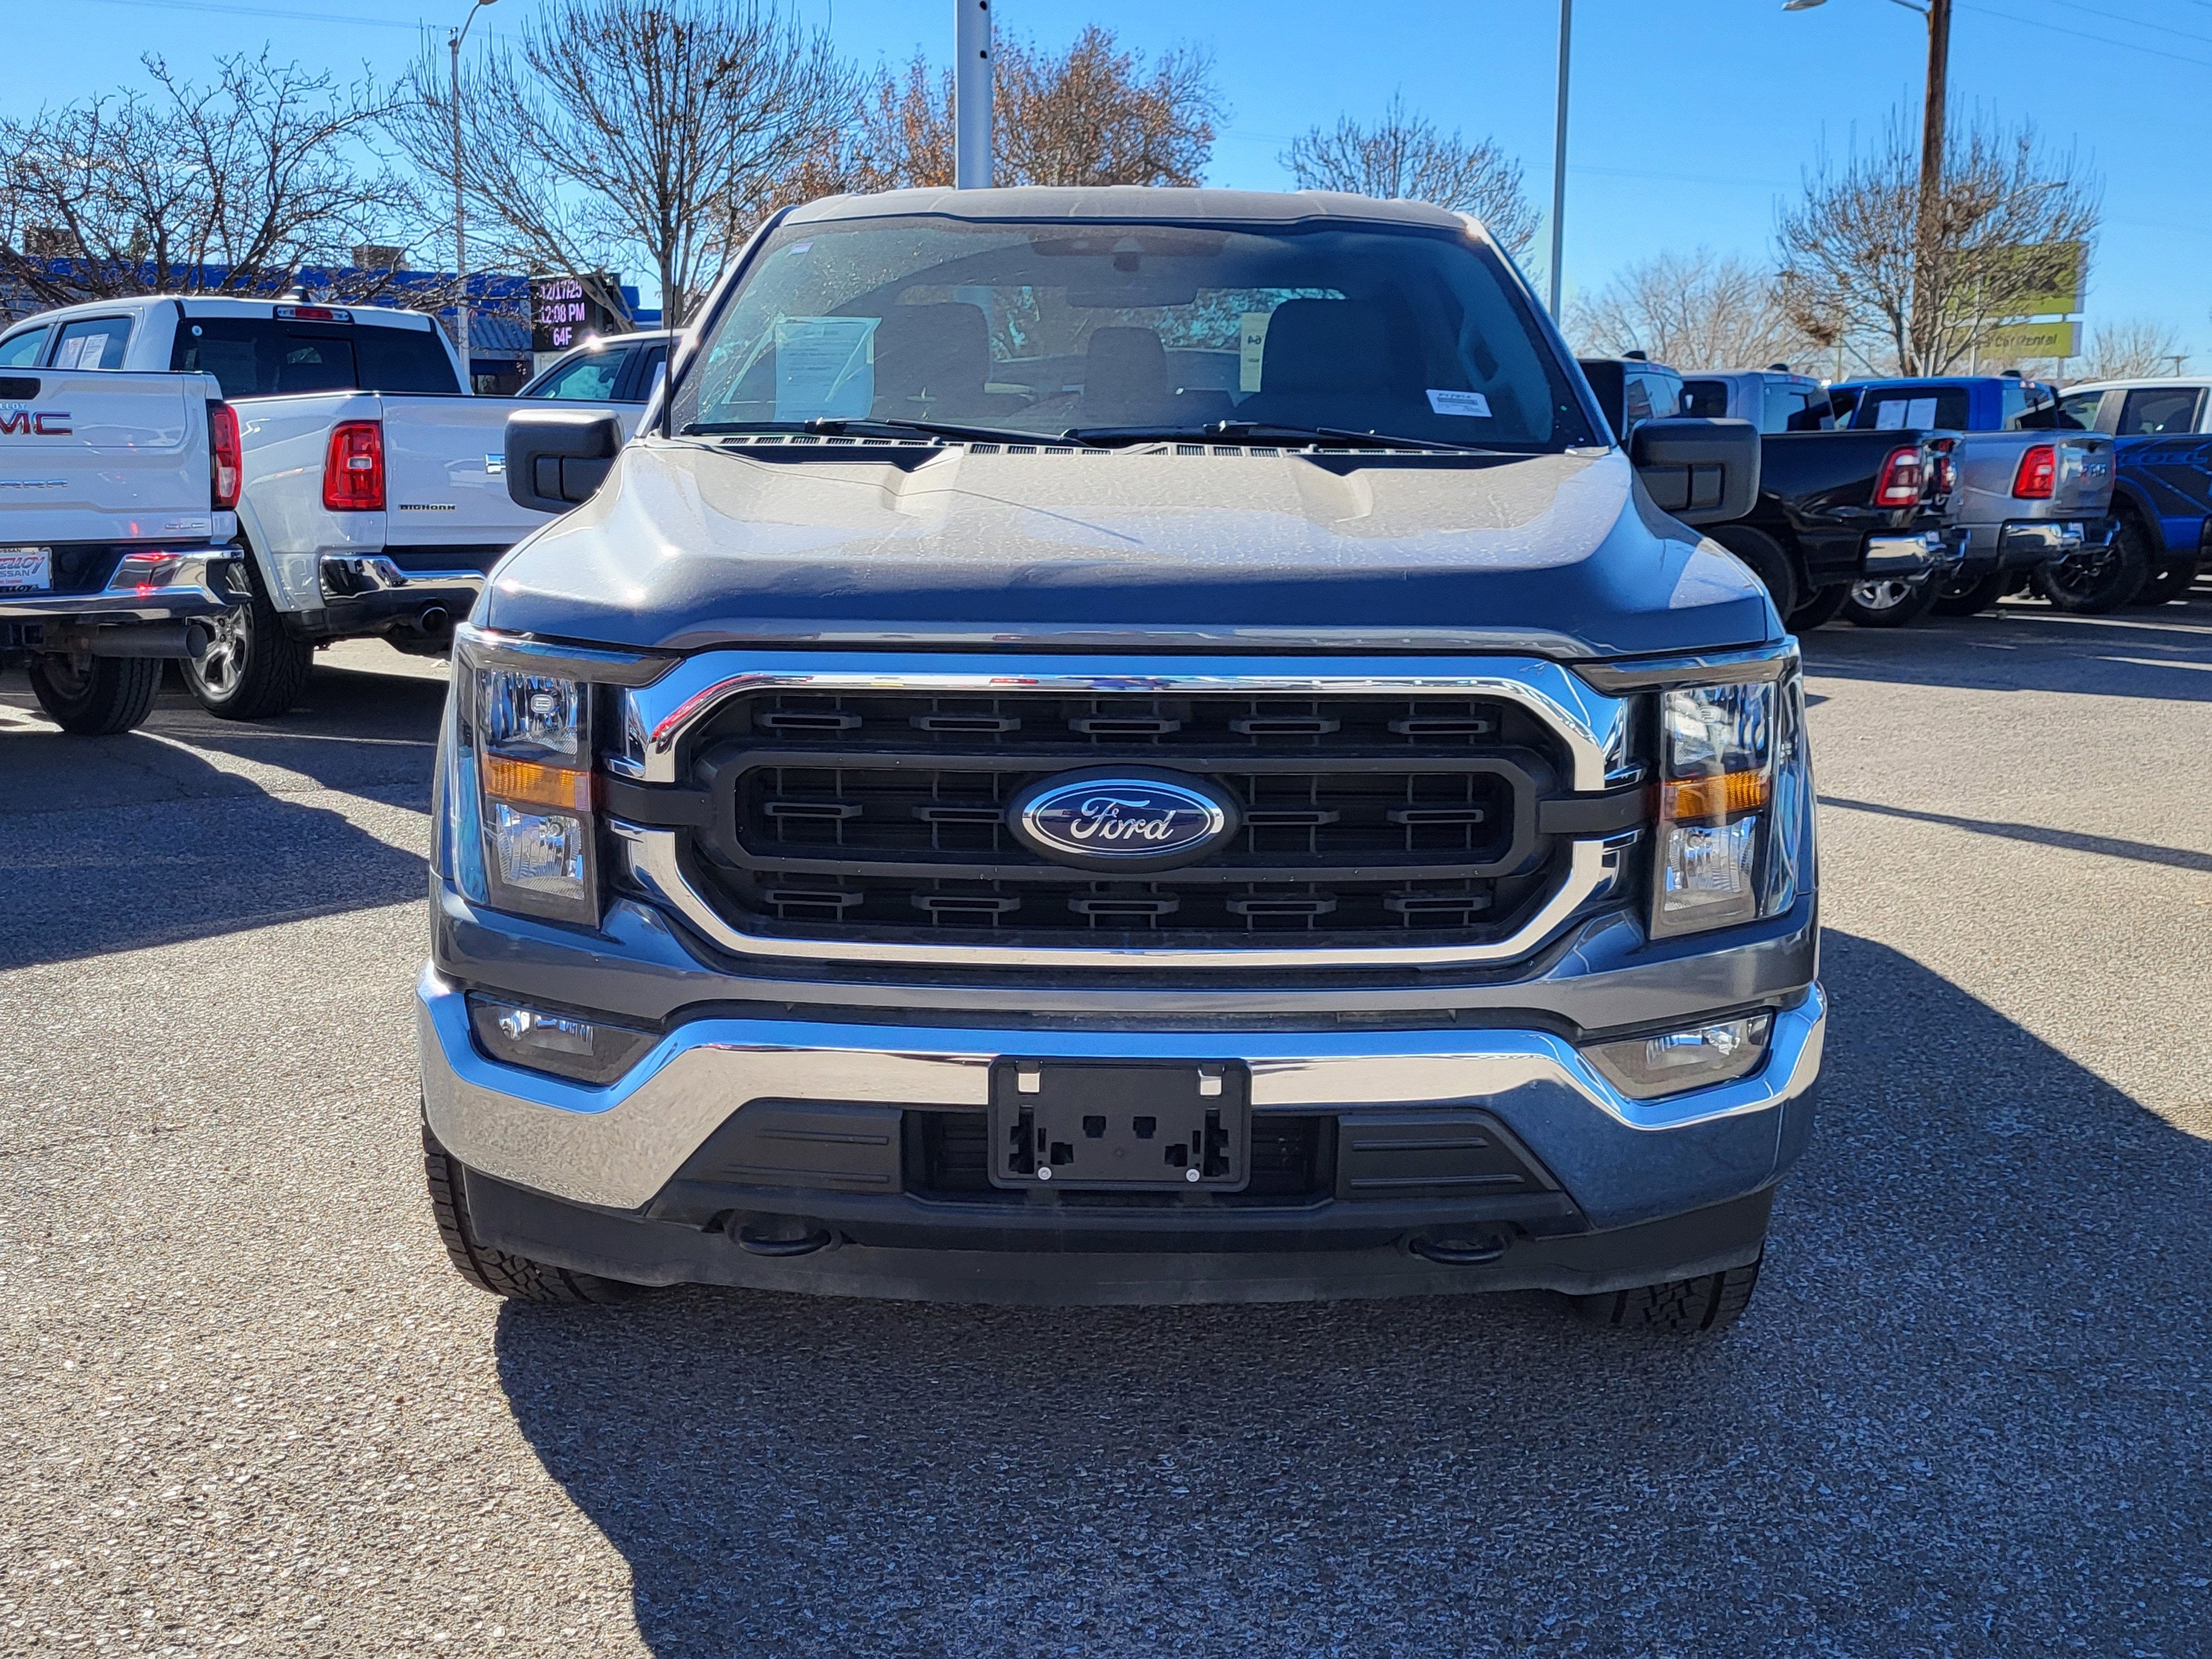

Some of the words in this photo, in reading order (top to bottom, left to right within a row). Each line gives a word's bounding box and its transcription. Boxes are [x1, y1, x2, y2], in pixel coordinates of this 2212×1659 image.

[541, 304, 566, 324] 12:08
[568, 302, 585, 322] PM
[553, 326, 572, 346] 64F
[1070, 797, 1177, 839] Ford
